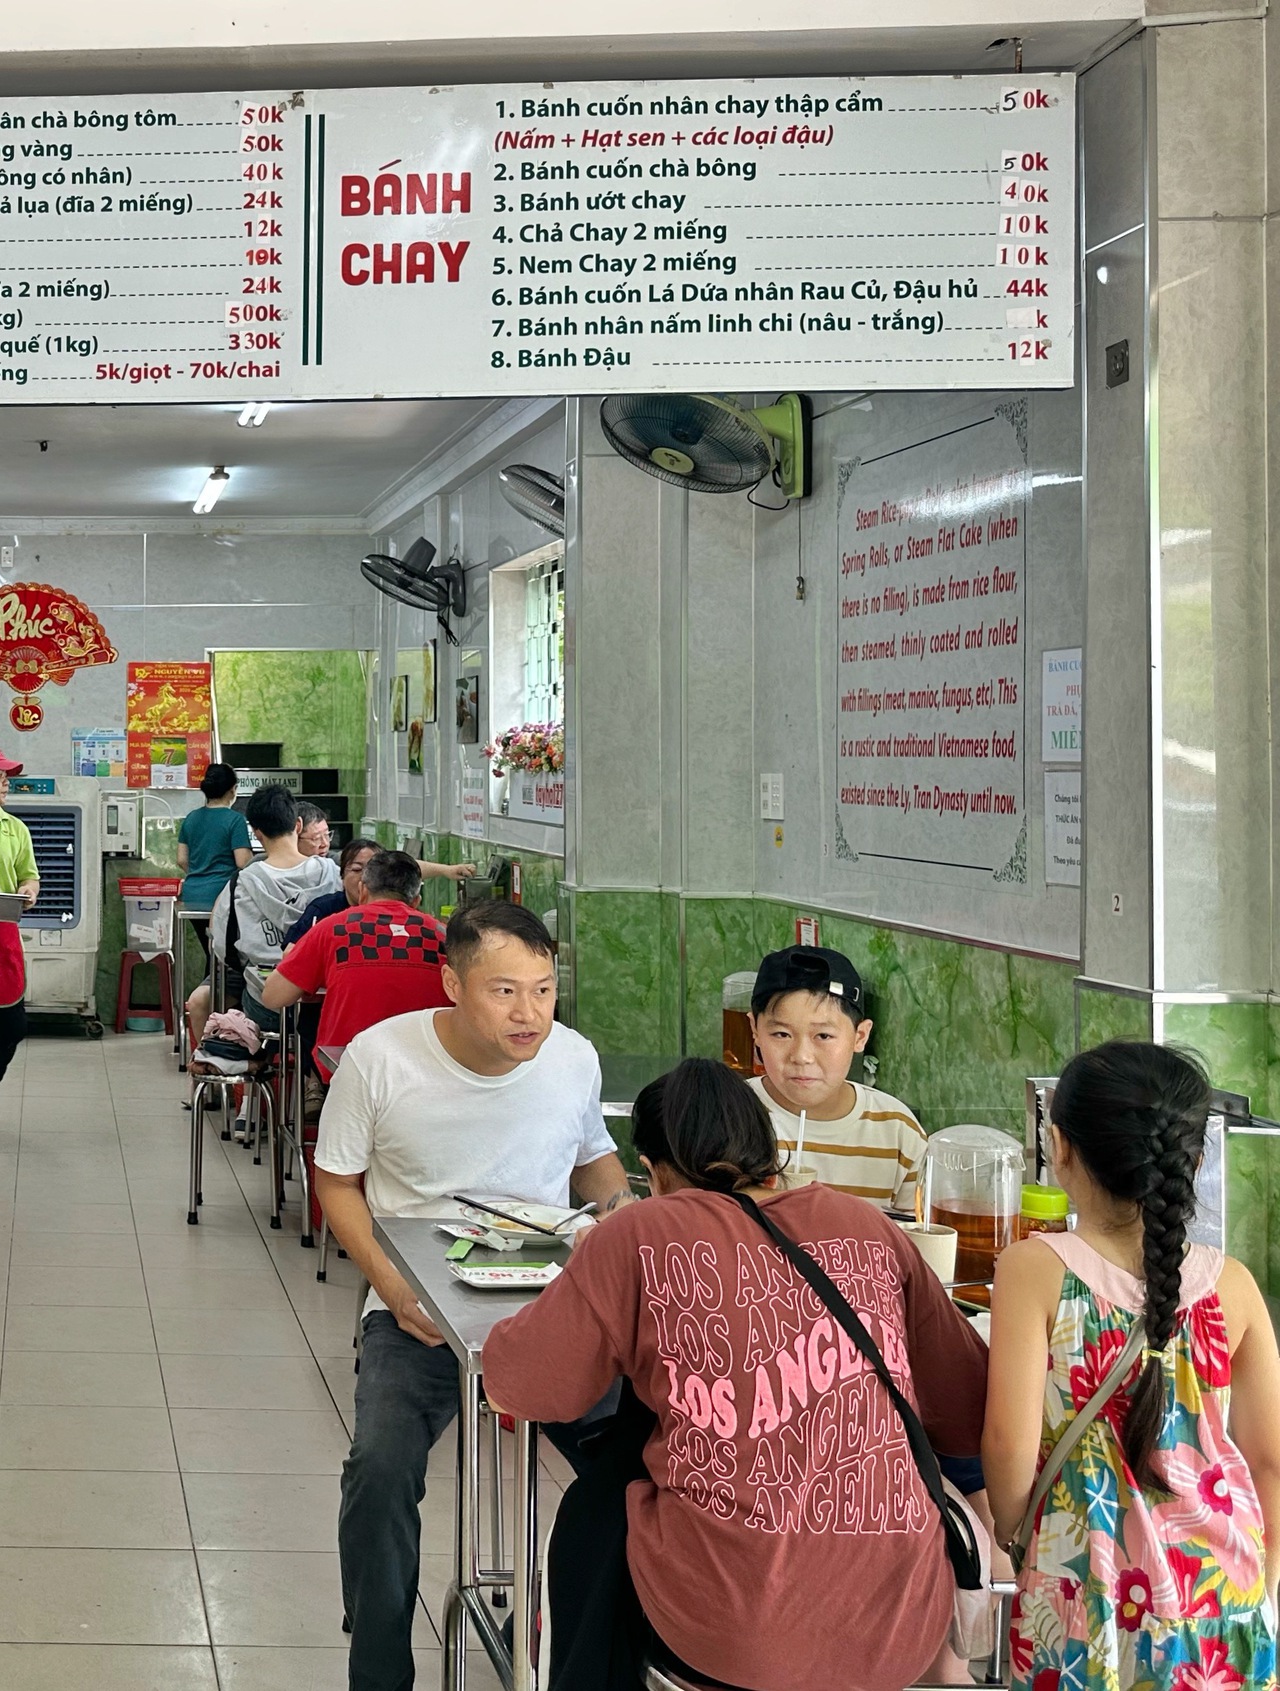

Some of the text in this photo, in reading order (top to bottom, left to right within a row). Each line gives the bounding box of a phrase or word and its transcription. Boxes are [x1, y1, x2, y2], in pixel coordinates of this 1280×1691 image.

[32, 111, 67, 128] chà
[74, 111, 128, 131] bông
[135, 109, 176, 126] tôm
[496, 101, 514, 118] 1.
[522, 98, 579, 117] Bánh
[587, 95, 642, 116] cuốn
[651, 96, 708, 114] nhân
[716, 95, 769, 118] chay
[775, 94, 829, 117] thập
[836, 90, 882, 111] cẩm
[341, 160, 471, 216] BÁNH
[245, 221, 282, 237] 12k
[342, 241, 470, 285] CHAY
[96, 363, 171, 383] 5k/giọt
[190, 361, 279, 378] 70k/chai
[842, 513, 1017, 579] Spring Rolls, or Steam Flat Cake (when
[842, 617, 1018, 662] then steamed, thinly coated and rolled
[163, 748, 176, 767] 7
[841, 731, 1016, 761] is a rustic and traditional Vietnamese food,
[841, 783, 1016, 817] existed since the Ly, Tran Dynasty until now.
[1113, 894, 1120, 912] 2
[639, 1241, 723, 1311] LOS
[649, 1301, 733, 1378] LOS
[663, 1360, 738, 1439] LOS
[668, 1409, 738, 1479] LOS
[745, 1445, 929, 1534] ANGELES
